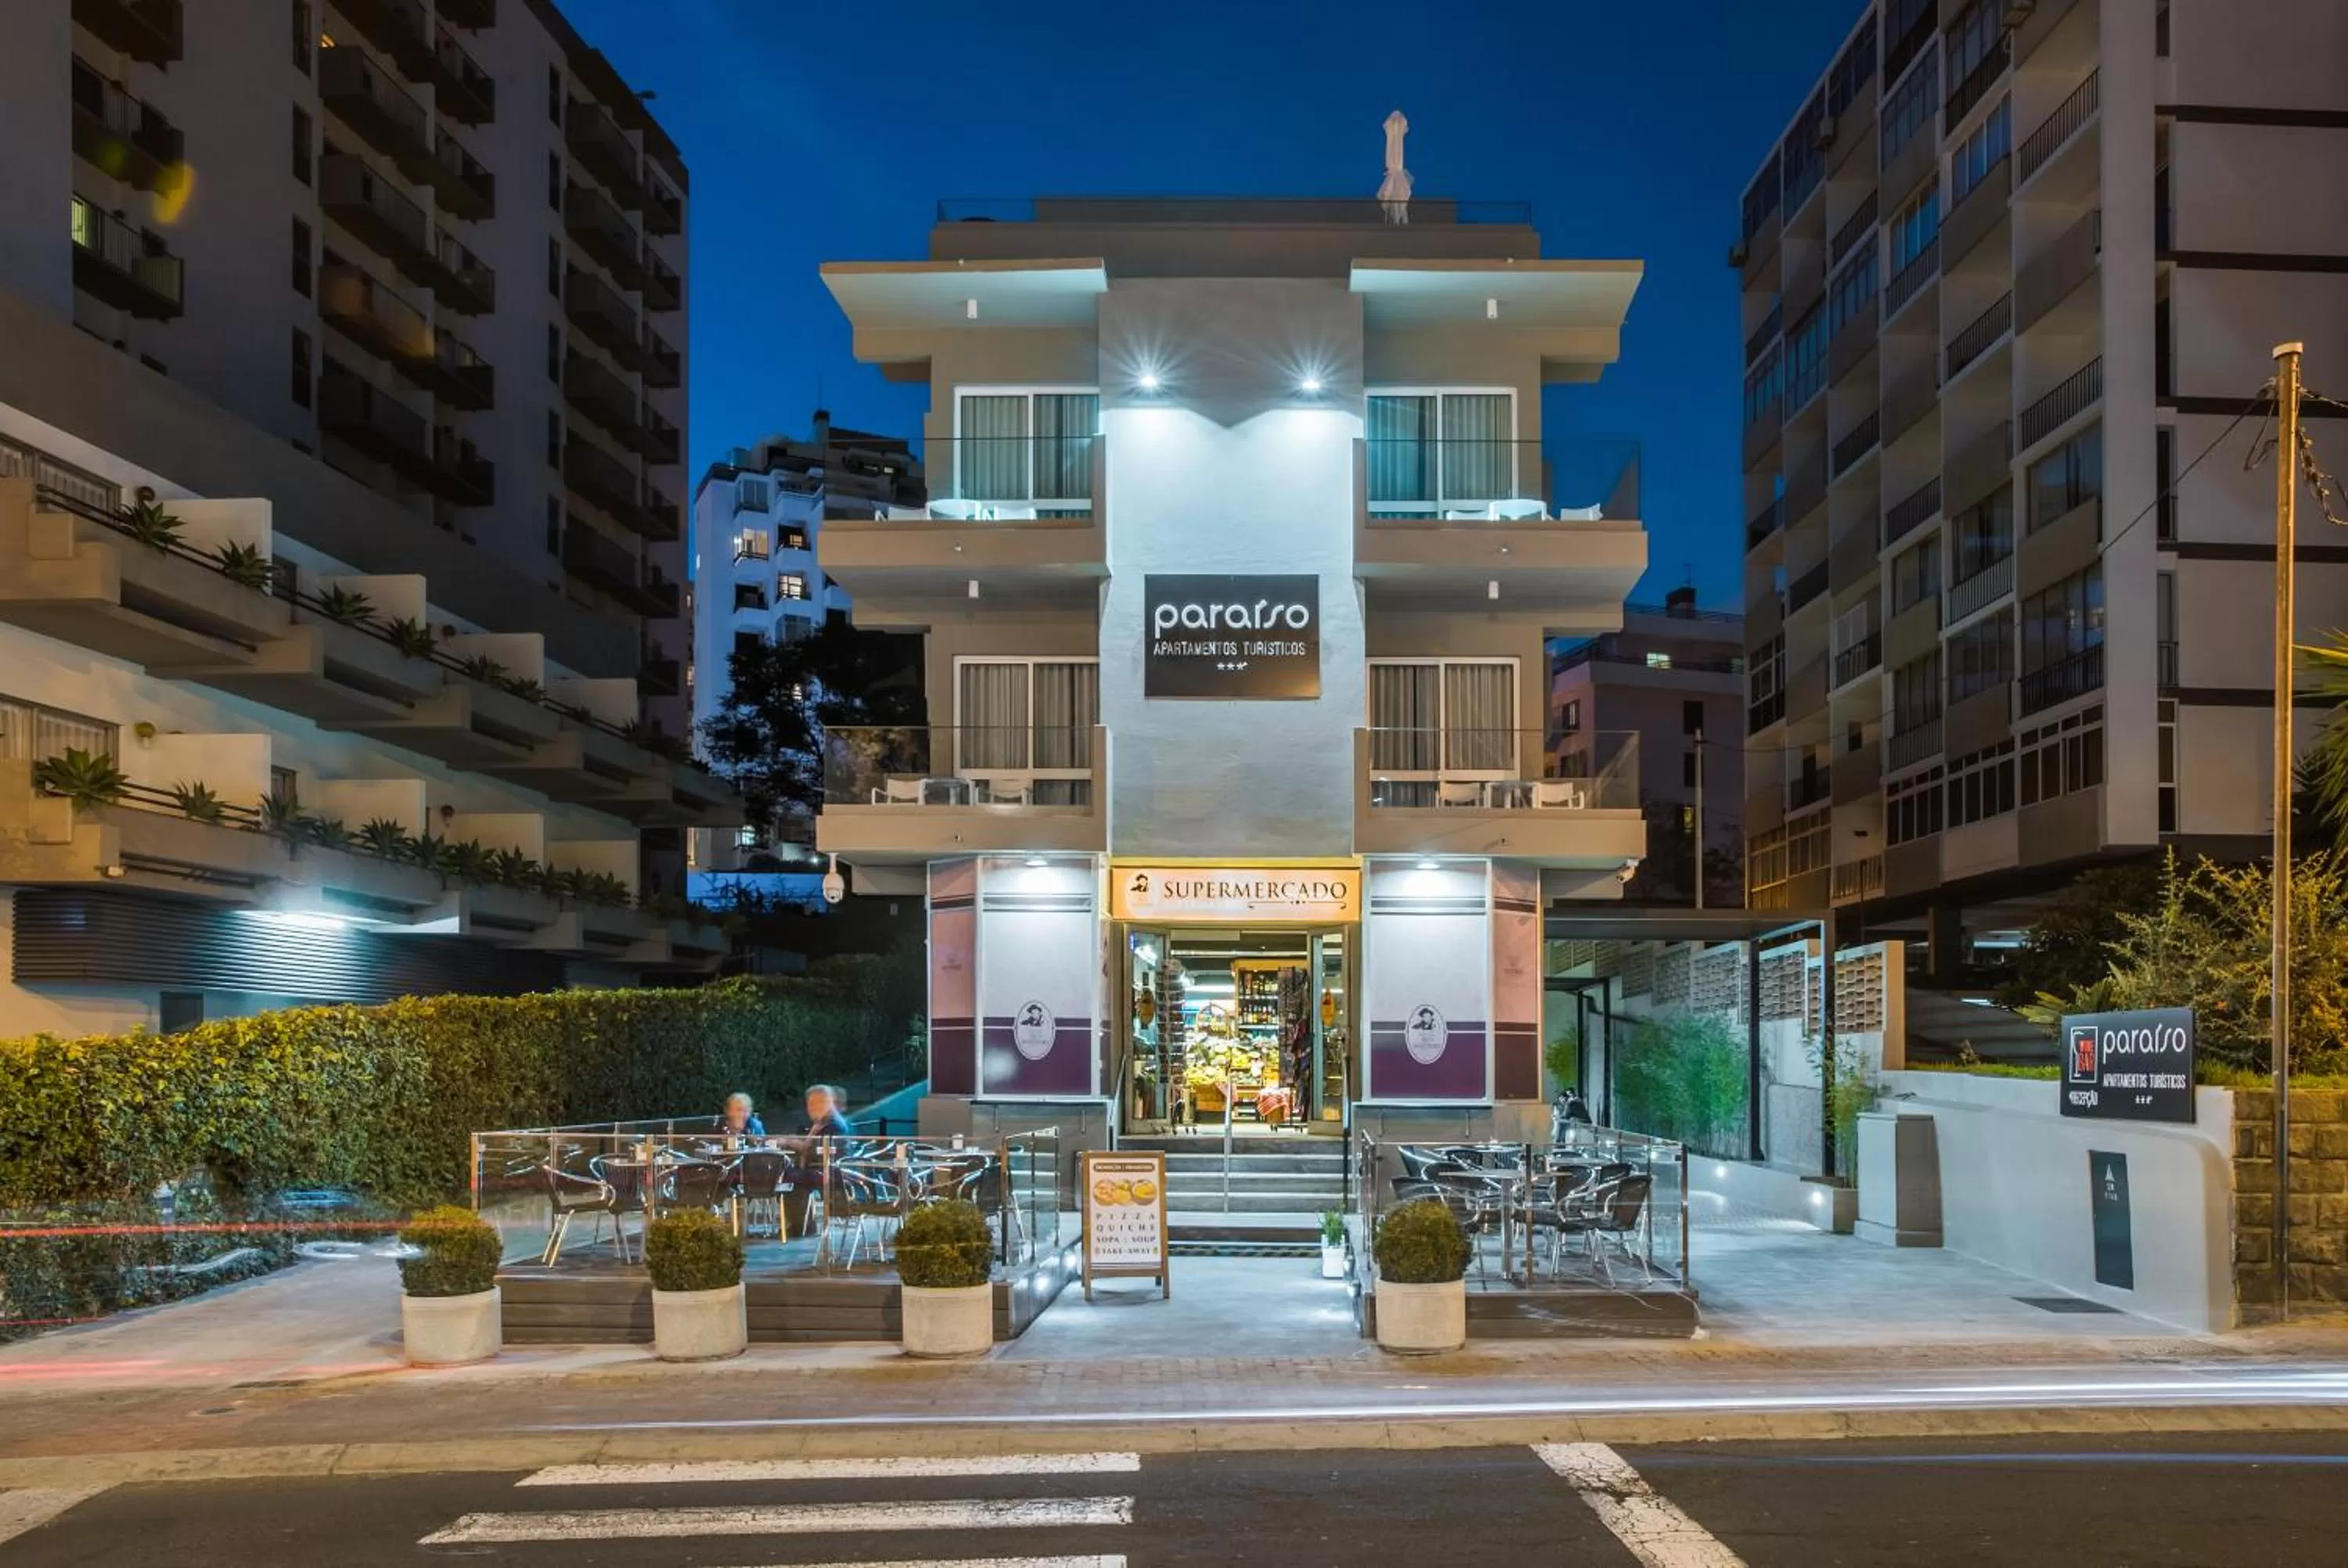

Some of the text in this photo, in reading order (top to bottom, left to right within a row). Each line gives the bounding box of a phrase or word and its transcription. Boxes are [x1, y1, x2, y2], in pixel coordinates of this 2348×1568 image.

[1153, 641, 1237, 656] APARTAMENTOS
[1164, 881, 1347, 899] SUPERMERCADO
[2103, 1073, 2148, 1088] APARTAMENTOS
[1097, 1224, 1154, 1233] QUICHE
